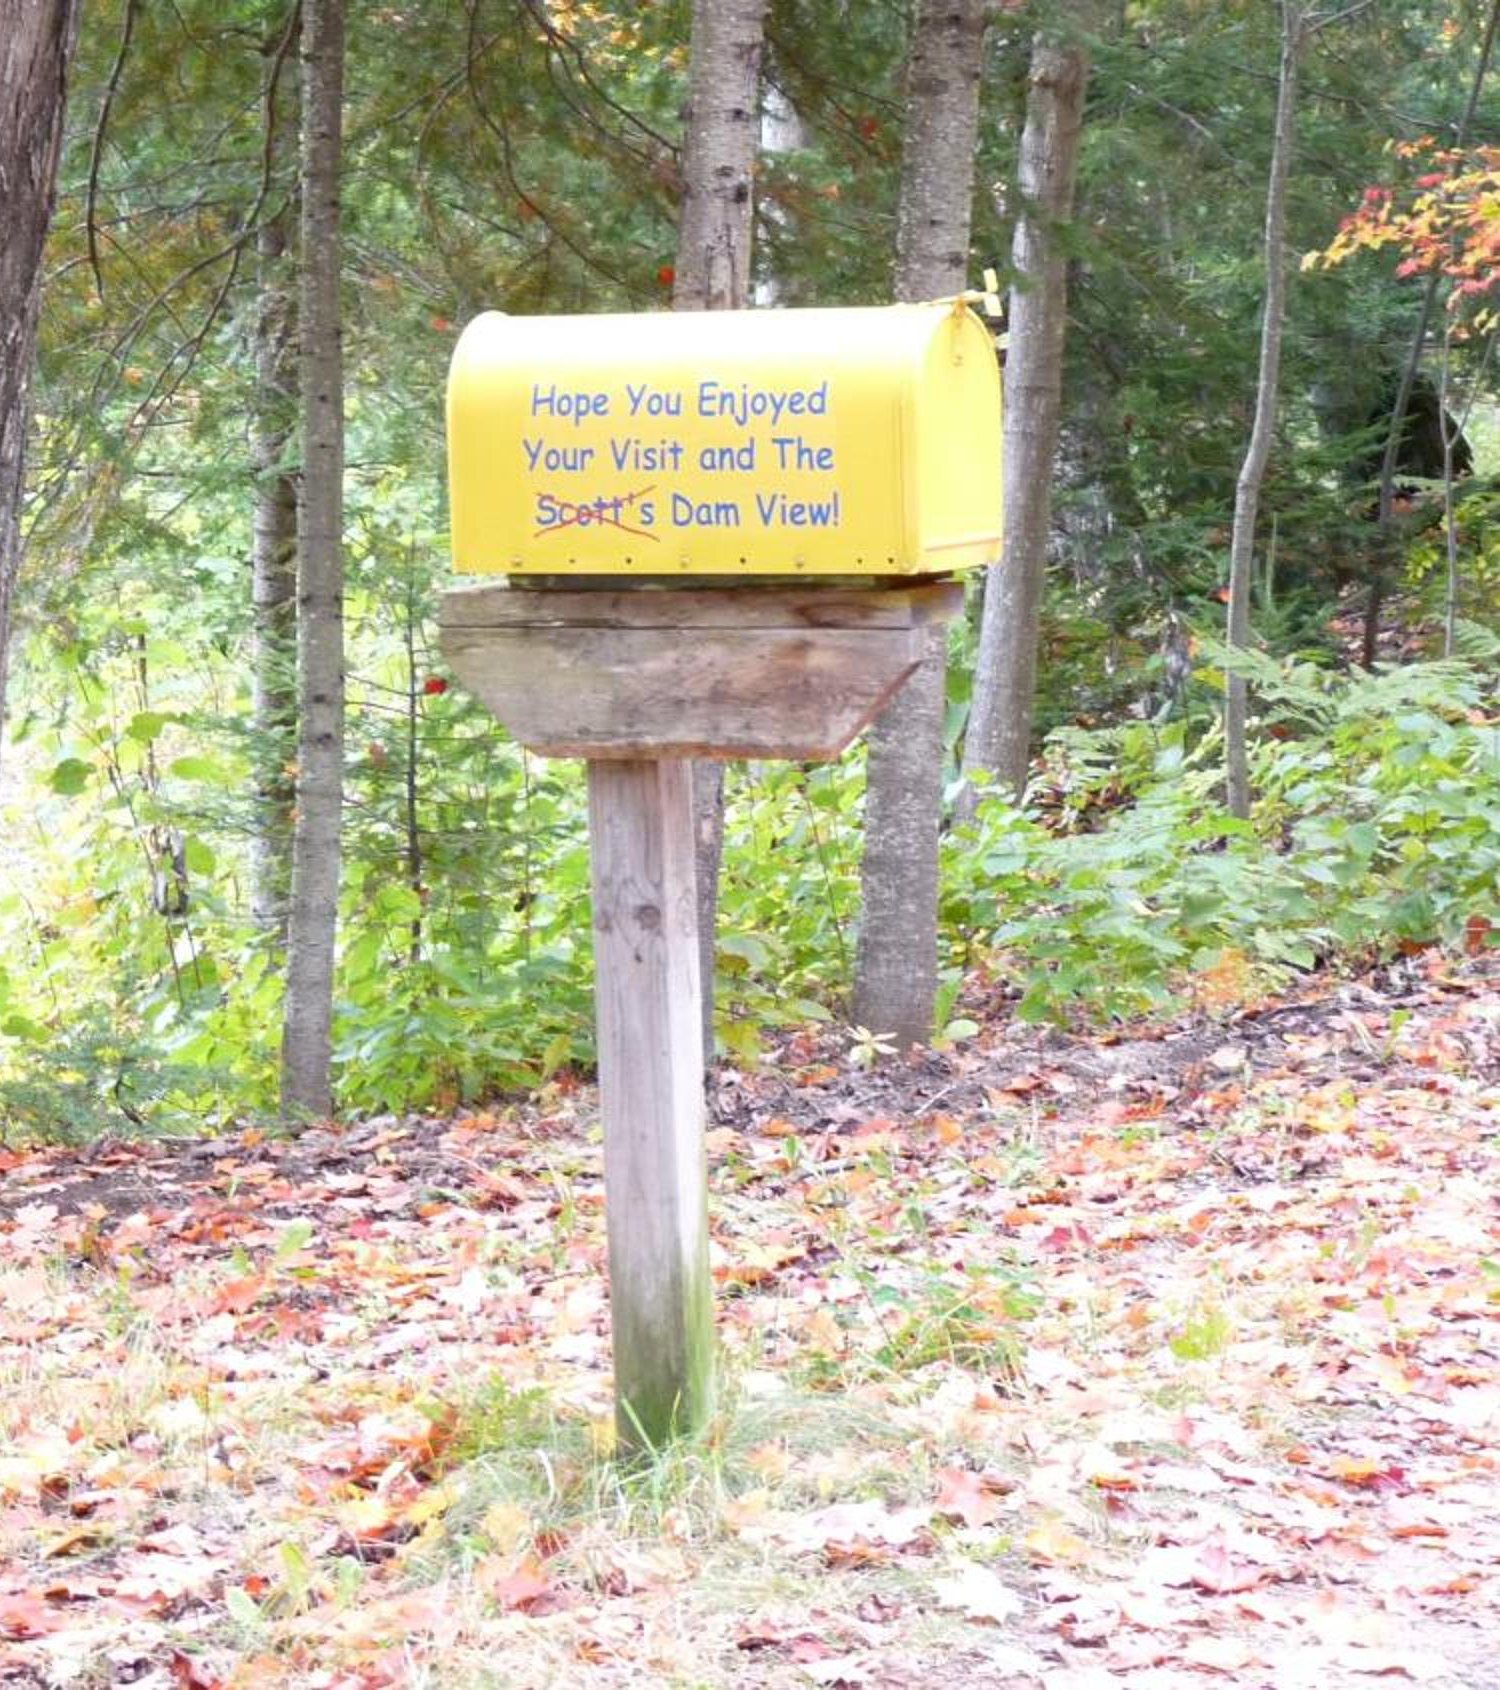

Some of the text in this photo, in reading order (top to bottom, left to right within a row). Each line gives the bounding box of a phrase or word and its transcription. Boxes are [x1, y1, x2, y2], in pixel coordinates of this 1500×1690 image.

[532, 381, 828, 426] Hope You Enjoyed
[523, 437, 834, 472] Your Visit and The
[536, 492, 840, 527] Scott's Dam View!
